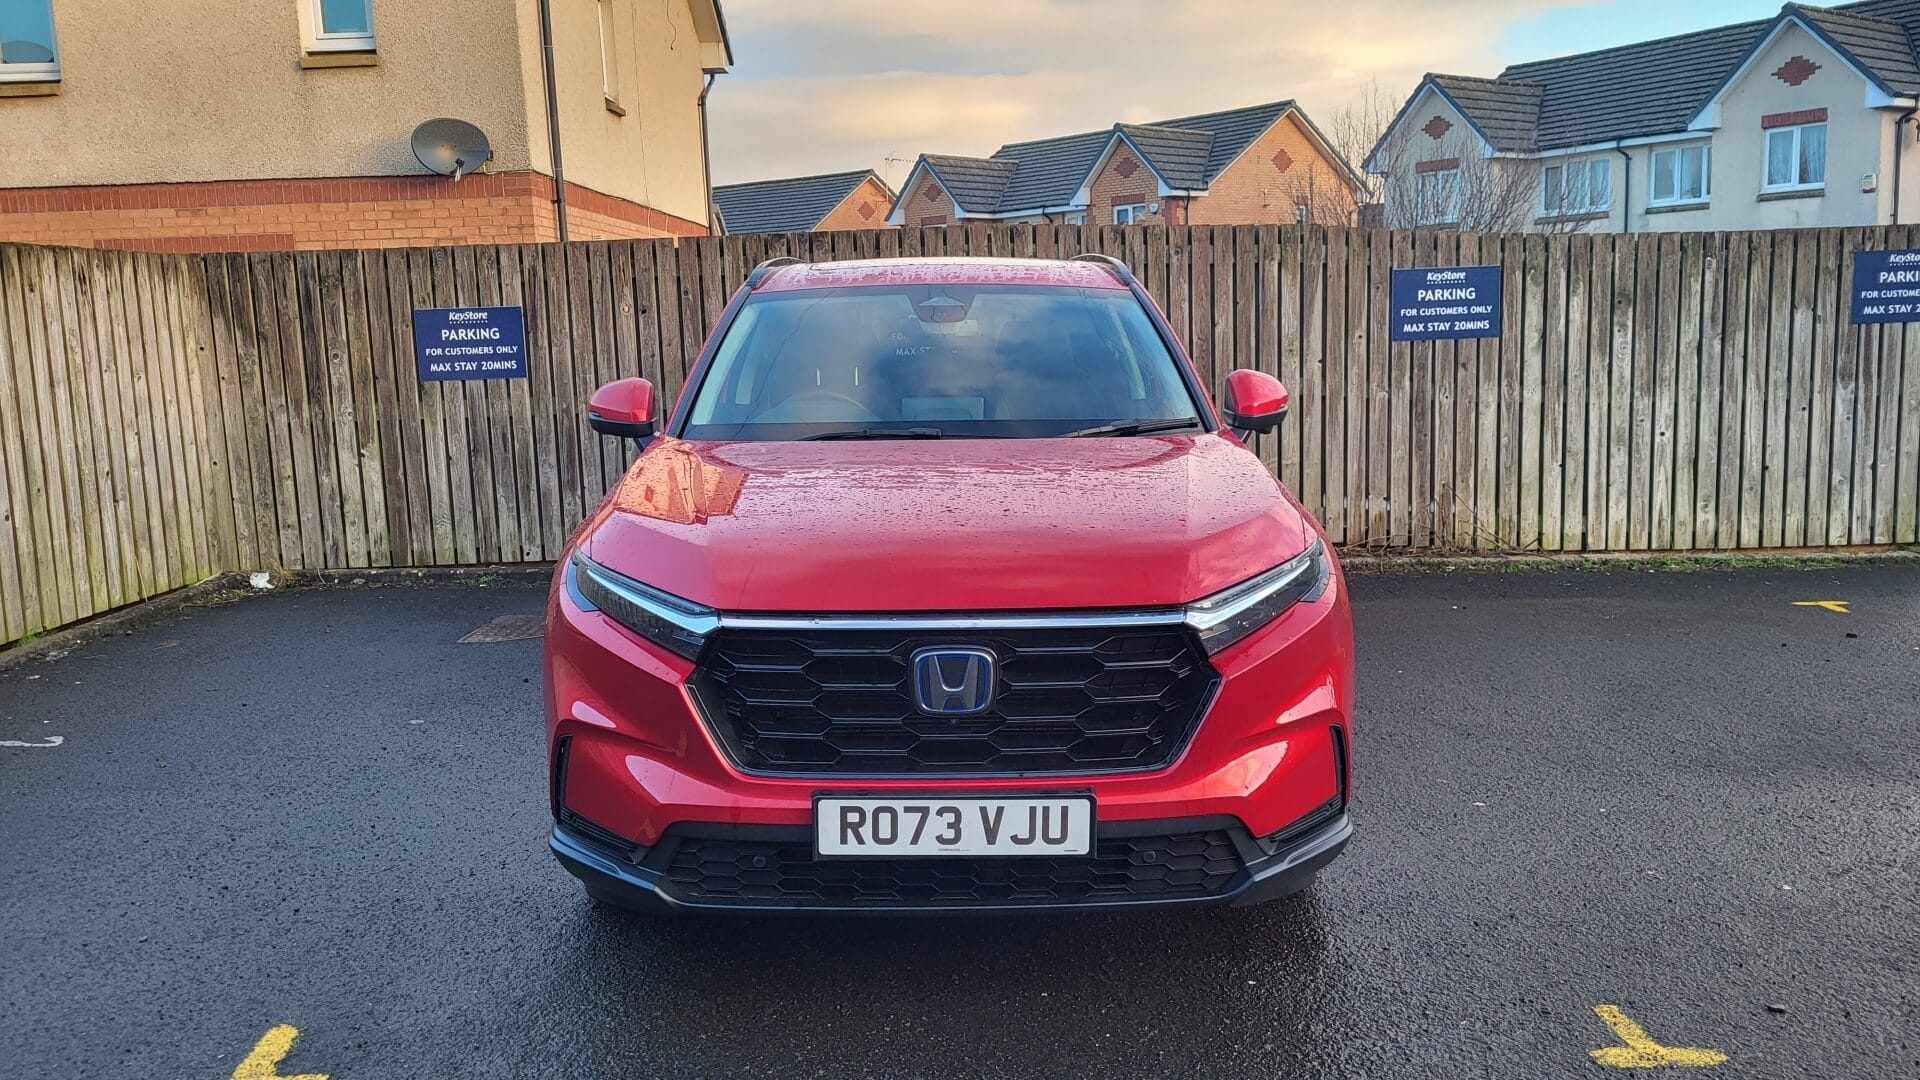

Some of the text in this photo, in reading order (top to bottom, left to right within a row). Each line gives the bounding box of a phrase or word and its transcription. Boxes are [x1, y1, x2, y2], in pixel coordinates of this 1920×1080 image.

[1889, 253, 1920, 263] KeySto
[1427, 271, 1466, 281] KeyStore
[1880, 270, 1920, 283] PARKI
[1417, 287, 1476, 301] PARKING
[1861, 289, 1920, 299] FOR CUSTOME
[1400, 305, 1493, 317] FOR CUSTOMERS ONLY
[1863, 305, 1885, 315] MAX
[1888, 304, 1913, 314] STAY
[449, 311, 488, 321] KeyStore
[1403, 320, 1490, 332] MAX STAY 20MINS
[441, 328, 500, 341] PARKING
[425, 345, 518, 356] FOR CUSTOMERS ONLY
[896, 347, 917, 356] MAX
[430, 360, 517, 372] MAX STAY 20MINS
[839, 805, 1069, 846] RO73 VJU
